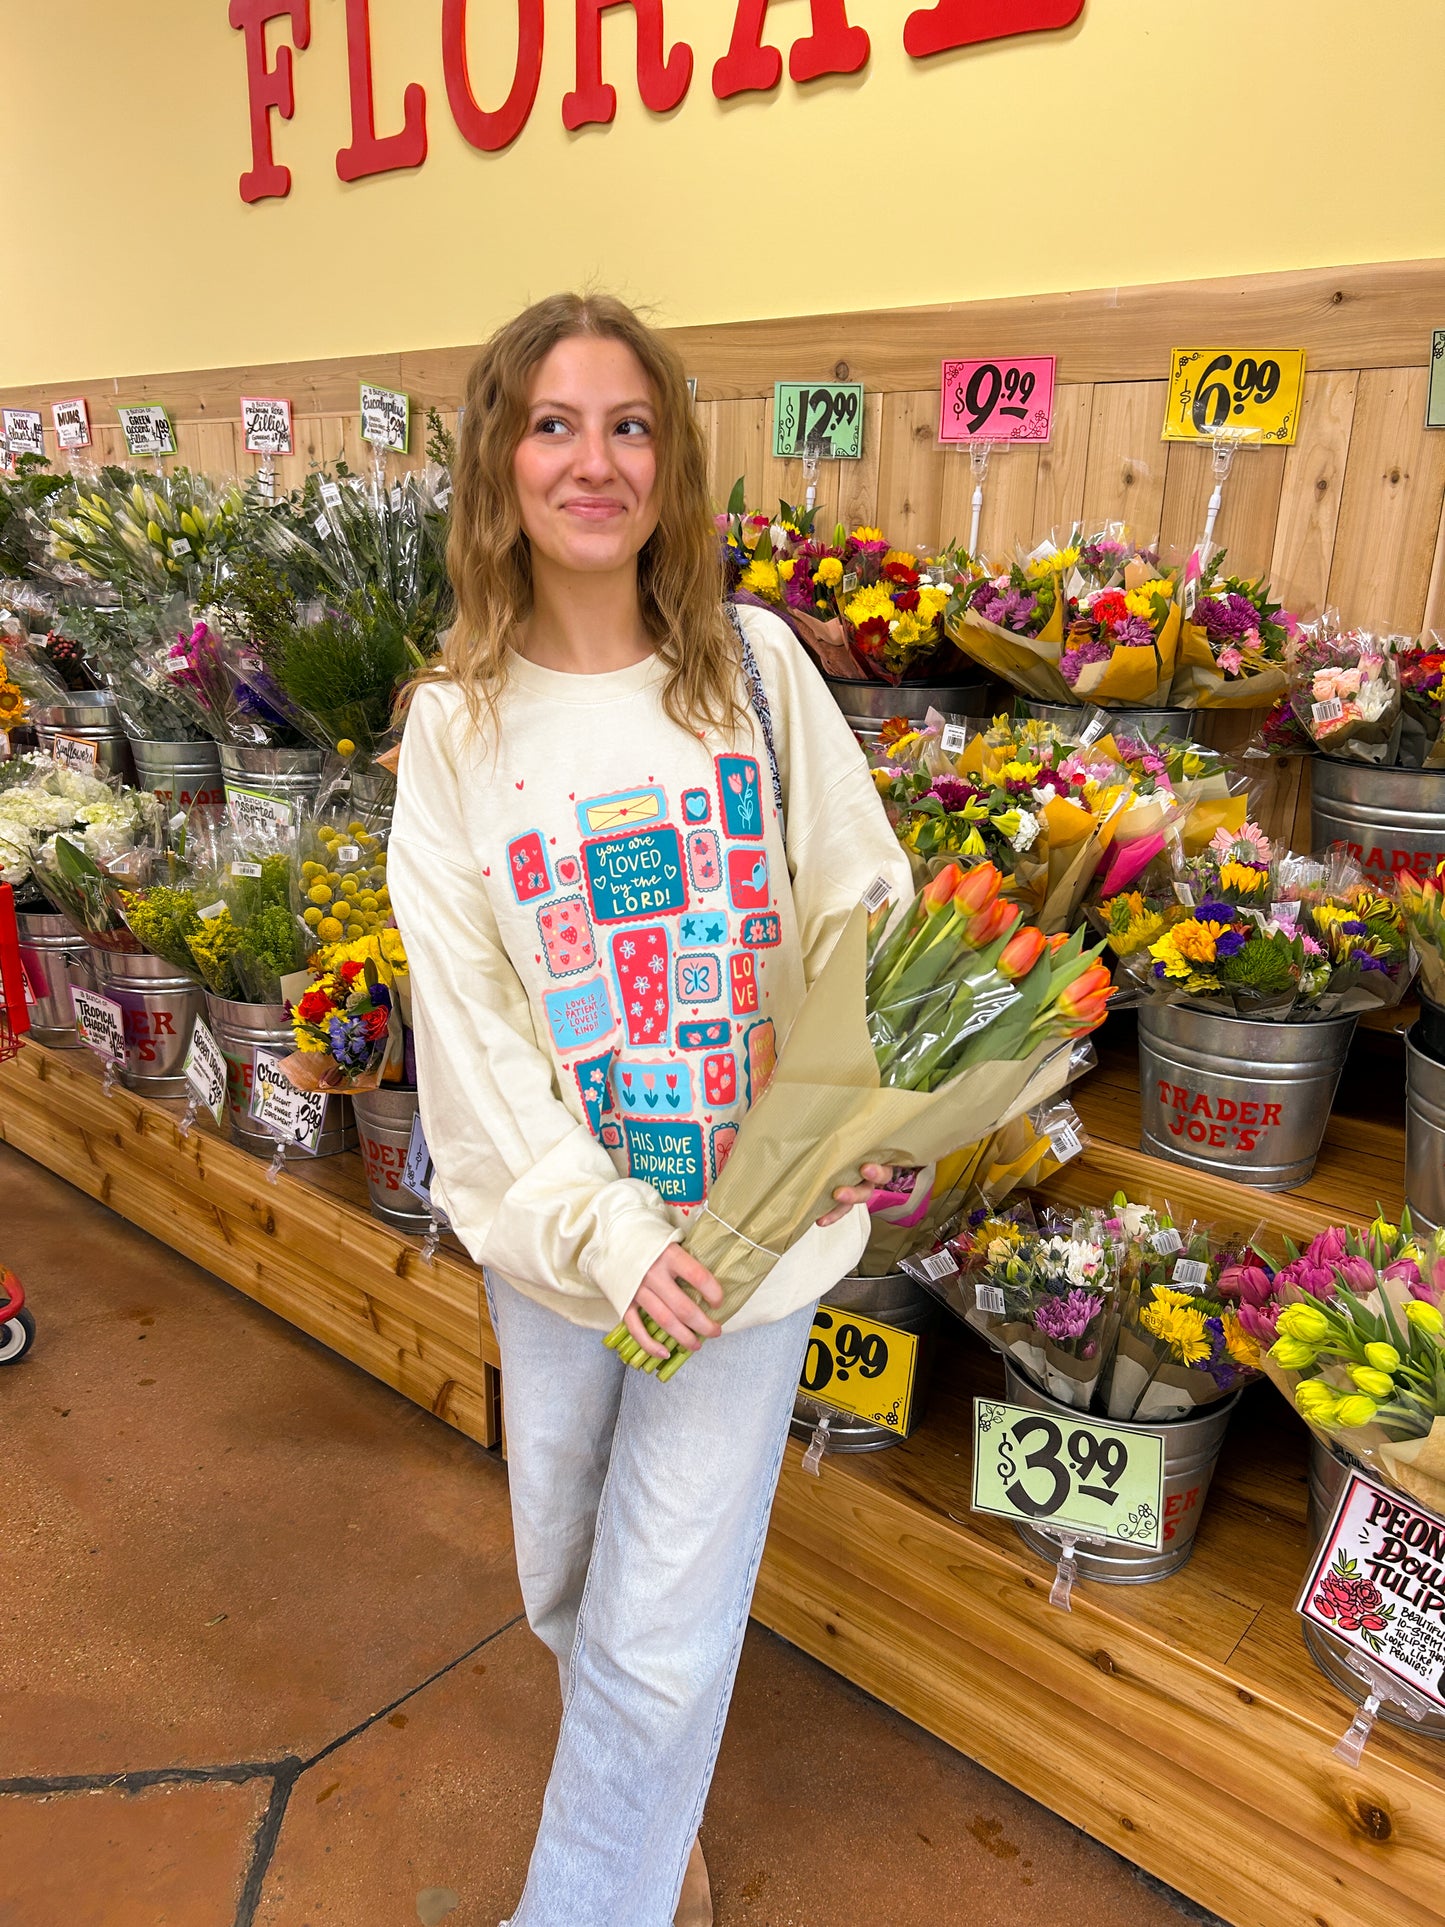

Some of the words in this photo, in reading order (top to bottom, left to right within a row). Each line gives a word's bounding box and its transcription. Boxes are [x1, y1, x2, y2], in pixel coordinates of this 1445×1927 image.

[229, 0, 1086, 204] FLOR
[362, 395, 406, 418] Eucalyptus
[953, 363, 1036, 435] $9.99
[57, 408, 81, 427] MUMS
[128, 415, 151, 426] GREEN
[247, 413, 289, 434] Lillies
[596, 843, 625, 867] you
[628, 836, 655, 850] are
[608, 849, 662, 878] LOVED
[1331, 838, 1445, 875] TRADE
[610, 882, 632, 898] by
[629, 874, 662, 888] the
[612, 887, 671, 915] LORD!
[75, 998, 117, 1030] TROPICAL
[565, 997, 587, 1010] LOVE
[83, 1015, 112, 1036] CHARM
[569, 1014, 591, 1028] LOVE
[1156, 1079, 1283, 1126] TRADER
[629, 1129, 655, 1152] HIS
[658, 1135, 692, 1155] LOVE
[1168, 1114, 1261, 1152] JOE'S
[633, 1152, 697, 1176] ENDURES
[996, 1416, 1129, 1518] $3.99
